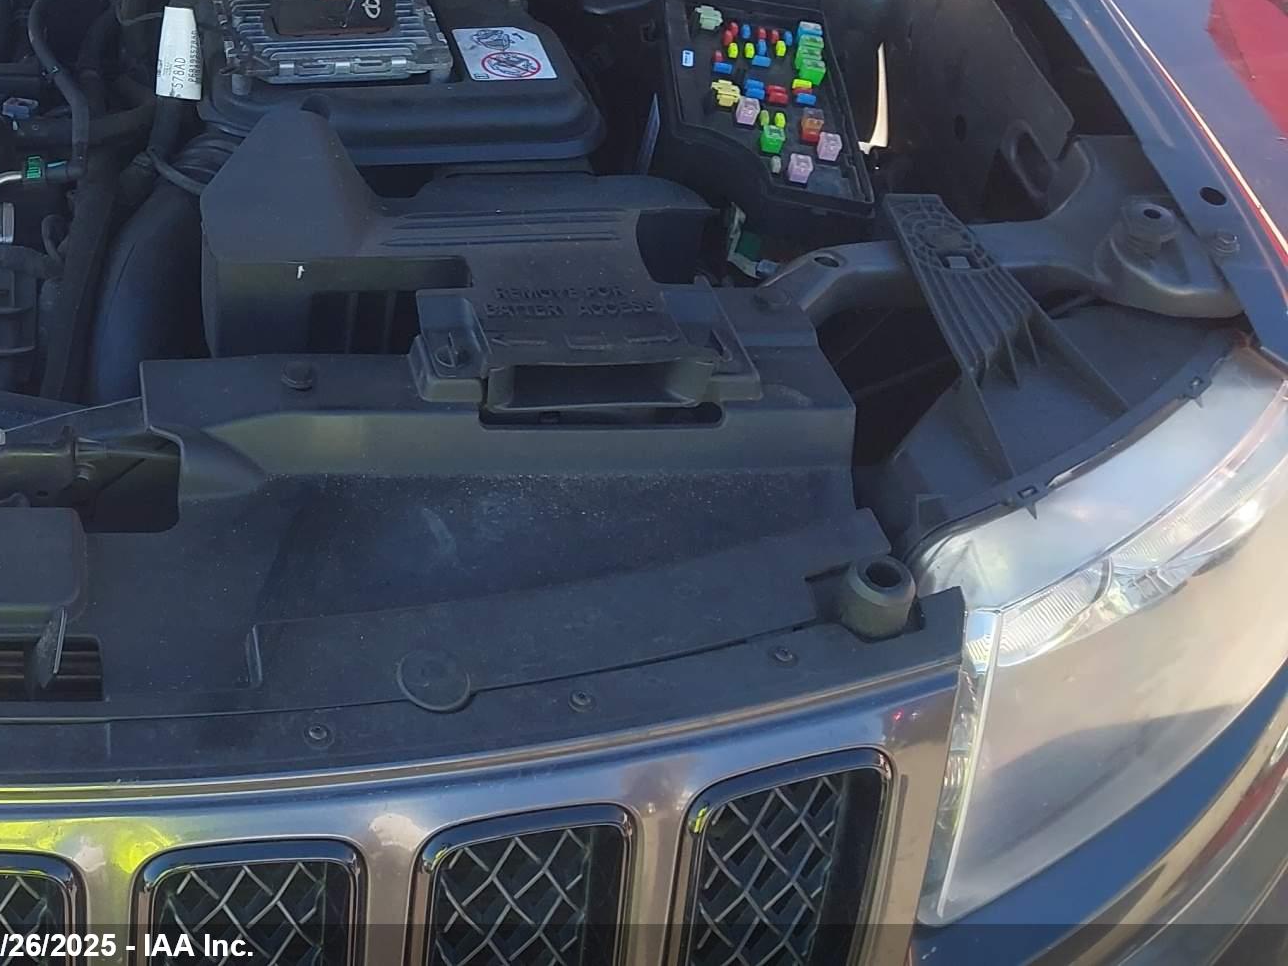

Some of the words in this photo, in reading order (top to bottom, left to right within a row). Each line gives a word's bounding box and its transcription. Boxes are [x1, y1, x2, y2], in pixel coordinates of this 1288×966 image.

[495, 287, 577, 299] REMOVE
[585, 285, 626, 298] FOR
[484, 301, 566, 316] BATTERY
[578, 299, 656, 316] ACCESS
